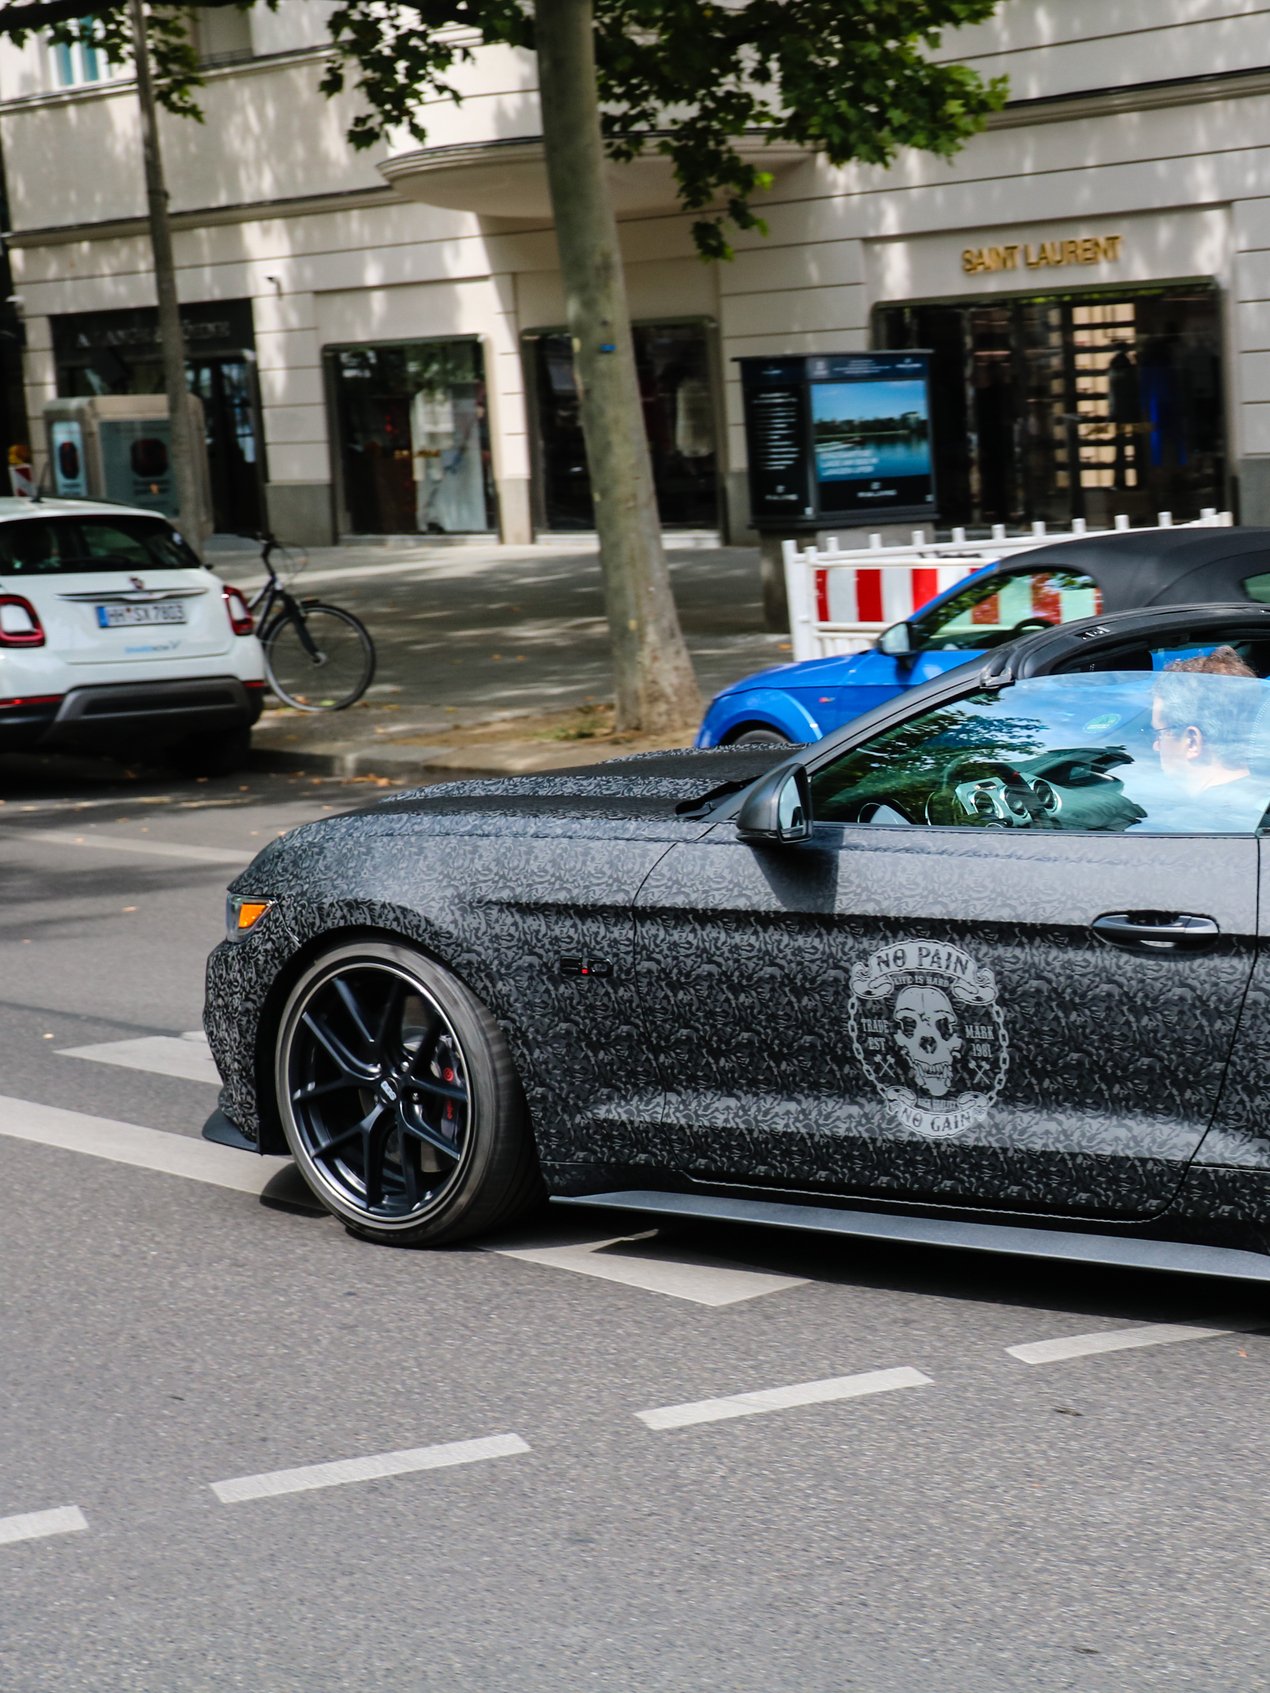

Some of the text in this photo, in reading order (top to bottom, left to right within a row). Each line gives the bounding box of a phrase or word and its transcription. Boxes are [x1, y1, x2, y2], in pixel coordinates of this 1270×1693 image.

[962, 234, 1122, 275] SAINT LAURENT
[876, 945, 971, 976] NO PAIN
[860, 1018, 995, 1040] TRADE MARK
[867, 1037, 993, 1058] EST 1981
[901, 1107, 972, 1132] NO GAIN
